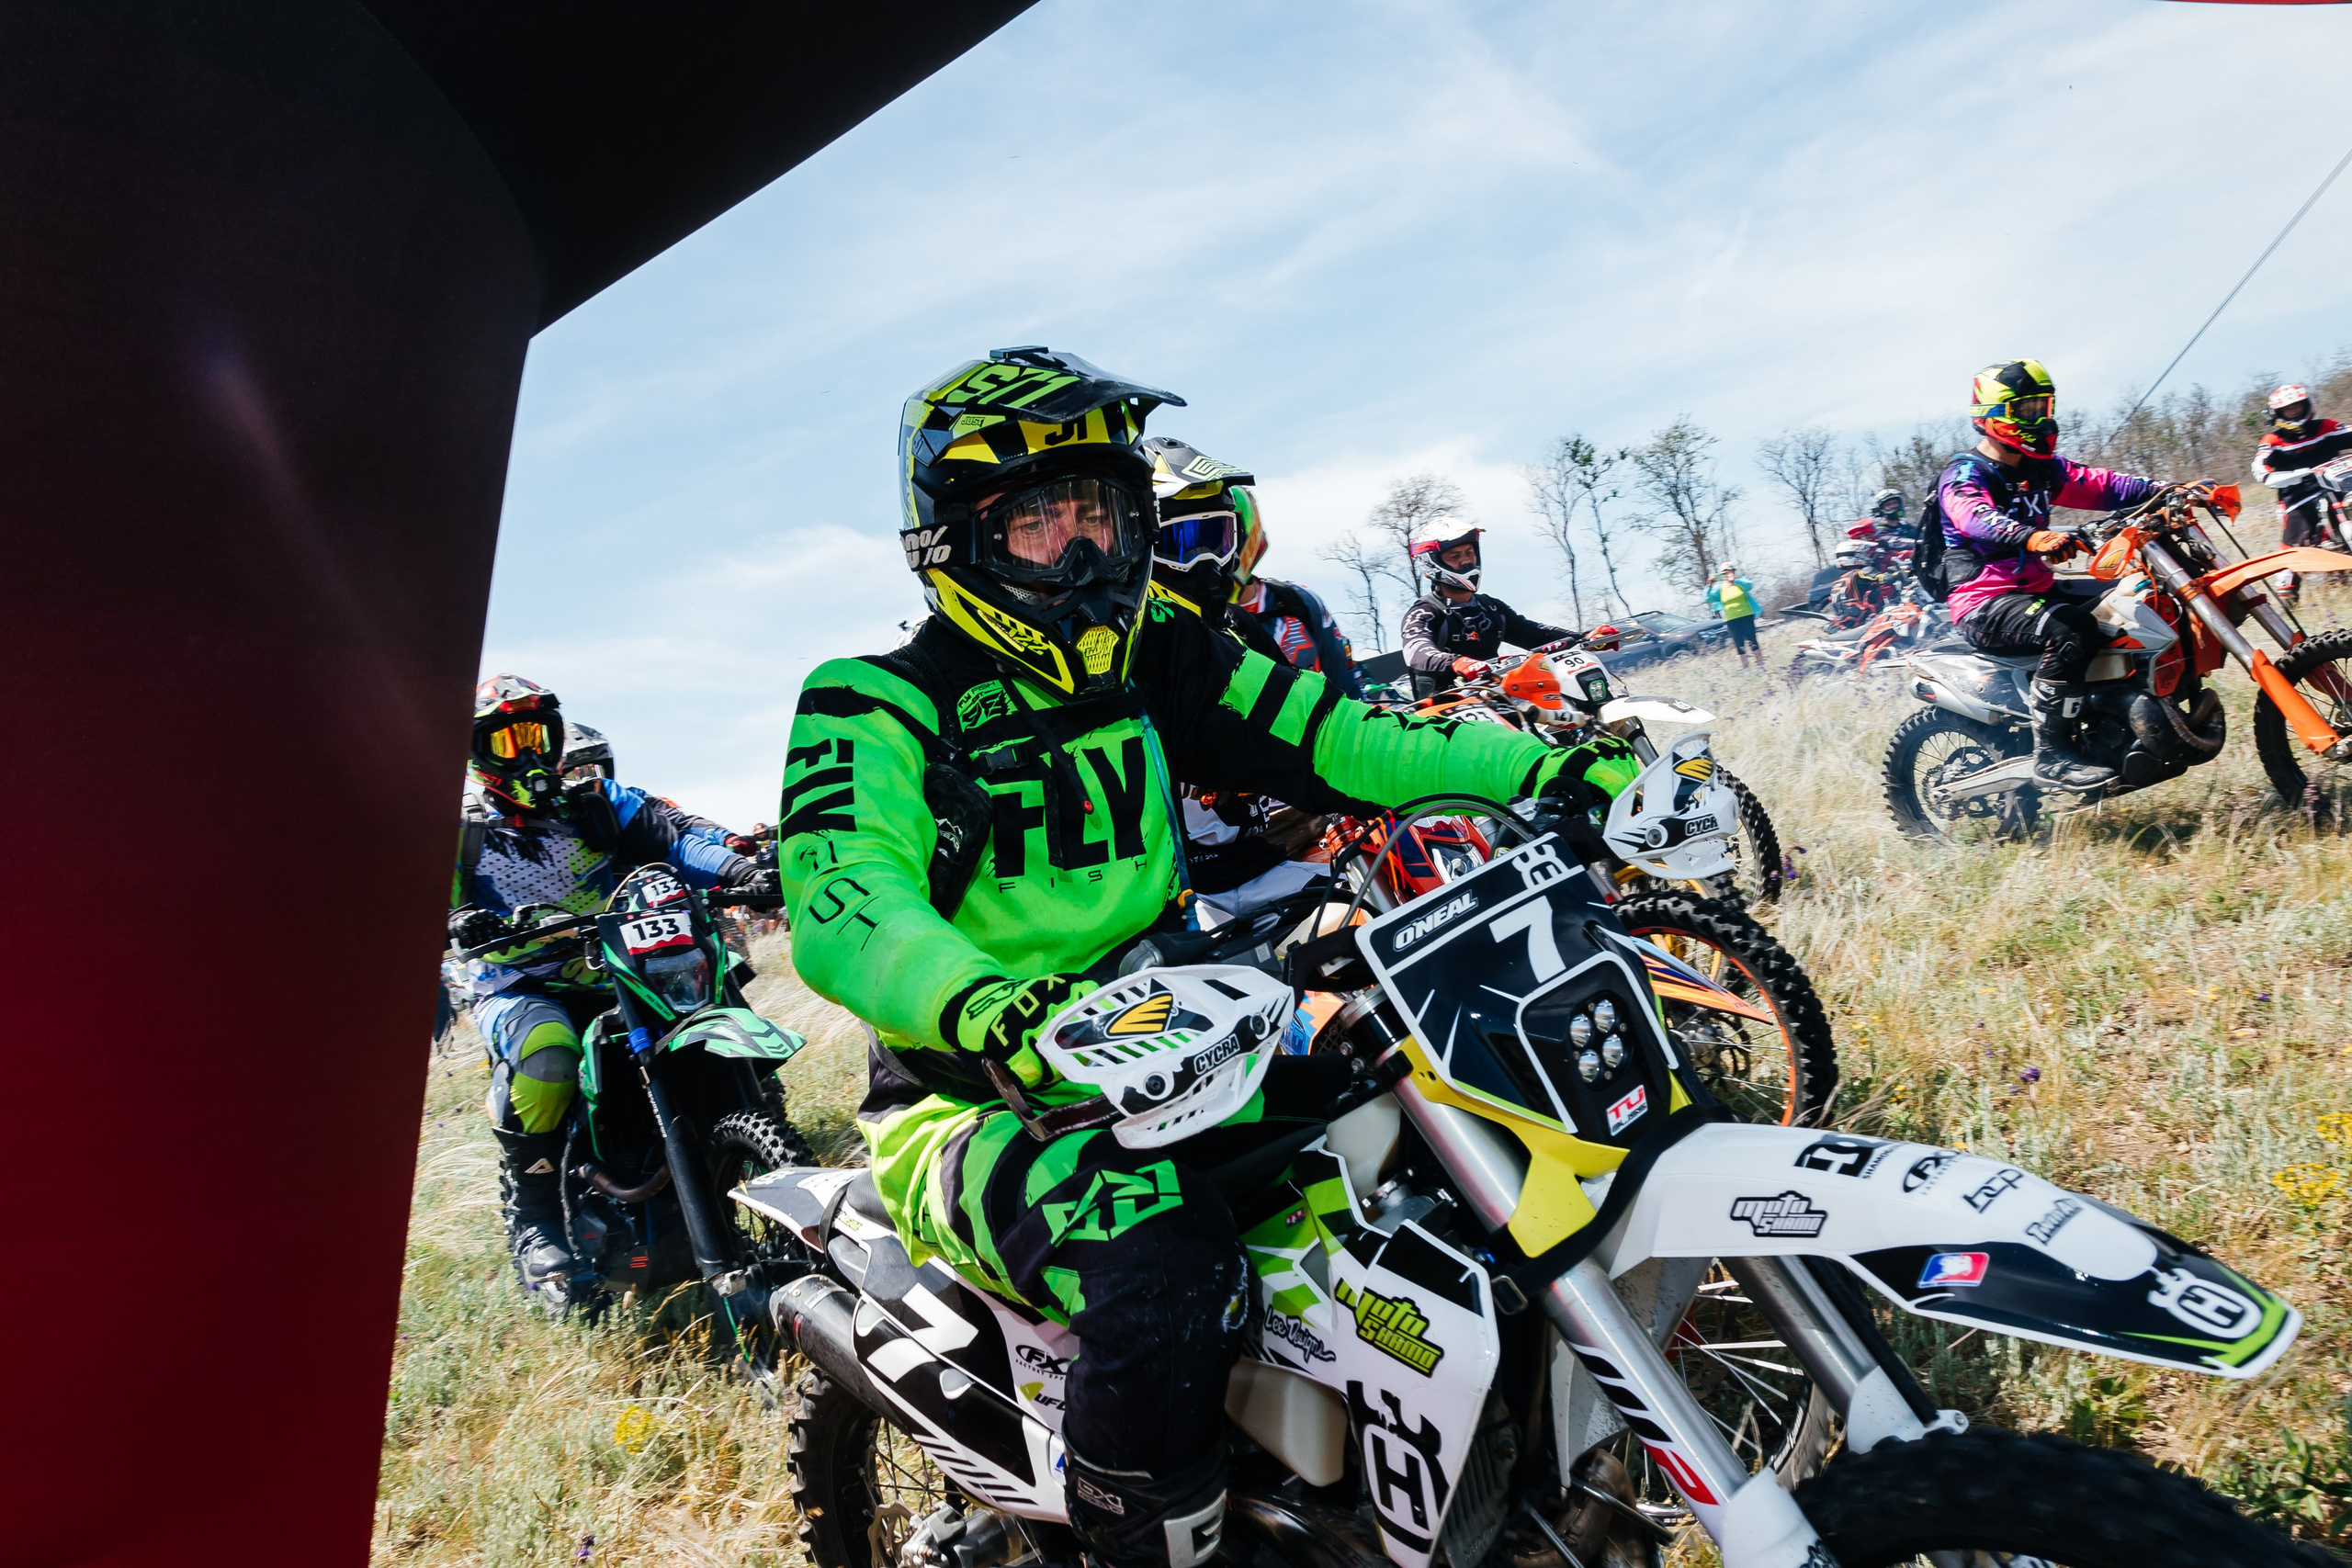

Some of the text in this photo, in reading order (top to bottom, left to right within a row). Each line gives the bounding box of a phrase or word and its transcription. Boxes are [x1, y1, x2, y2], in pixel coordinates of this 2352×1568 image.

[1565, 657, 1585, 668] 90
[781, 738, 857, 844] FLY
[983, 735, 1148, 880] FLY
[1685, 814, 1720, 837] CYCR
[998, 855, 1148, 894] FISH
[632, 918, 680, 942] 133
[1488, 895, 1566, 984] 7
[990, 972, 1067, 1047] FOX
[1193, 1033, 1240, 1076] CYCRA
[1608, 1088, 1645, 1120] TU
[867, 1282, 979, 1383] 7
[1015, 1359, 1065, 1382] FACTORY EFF
